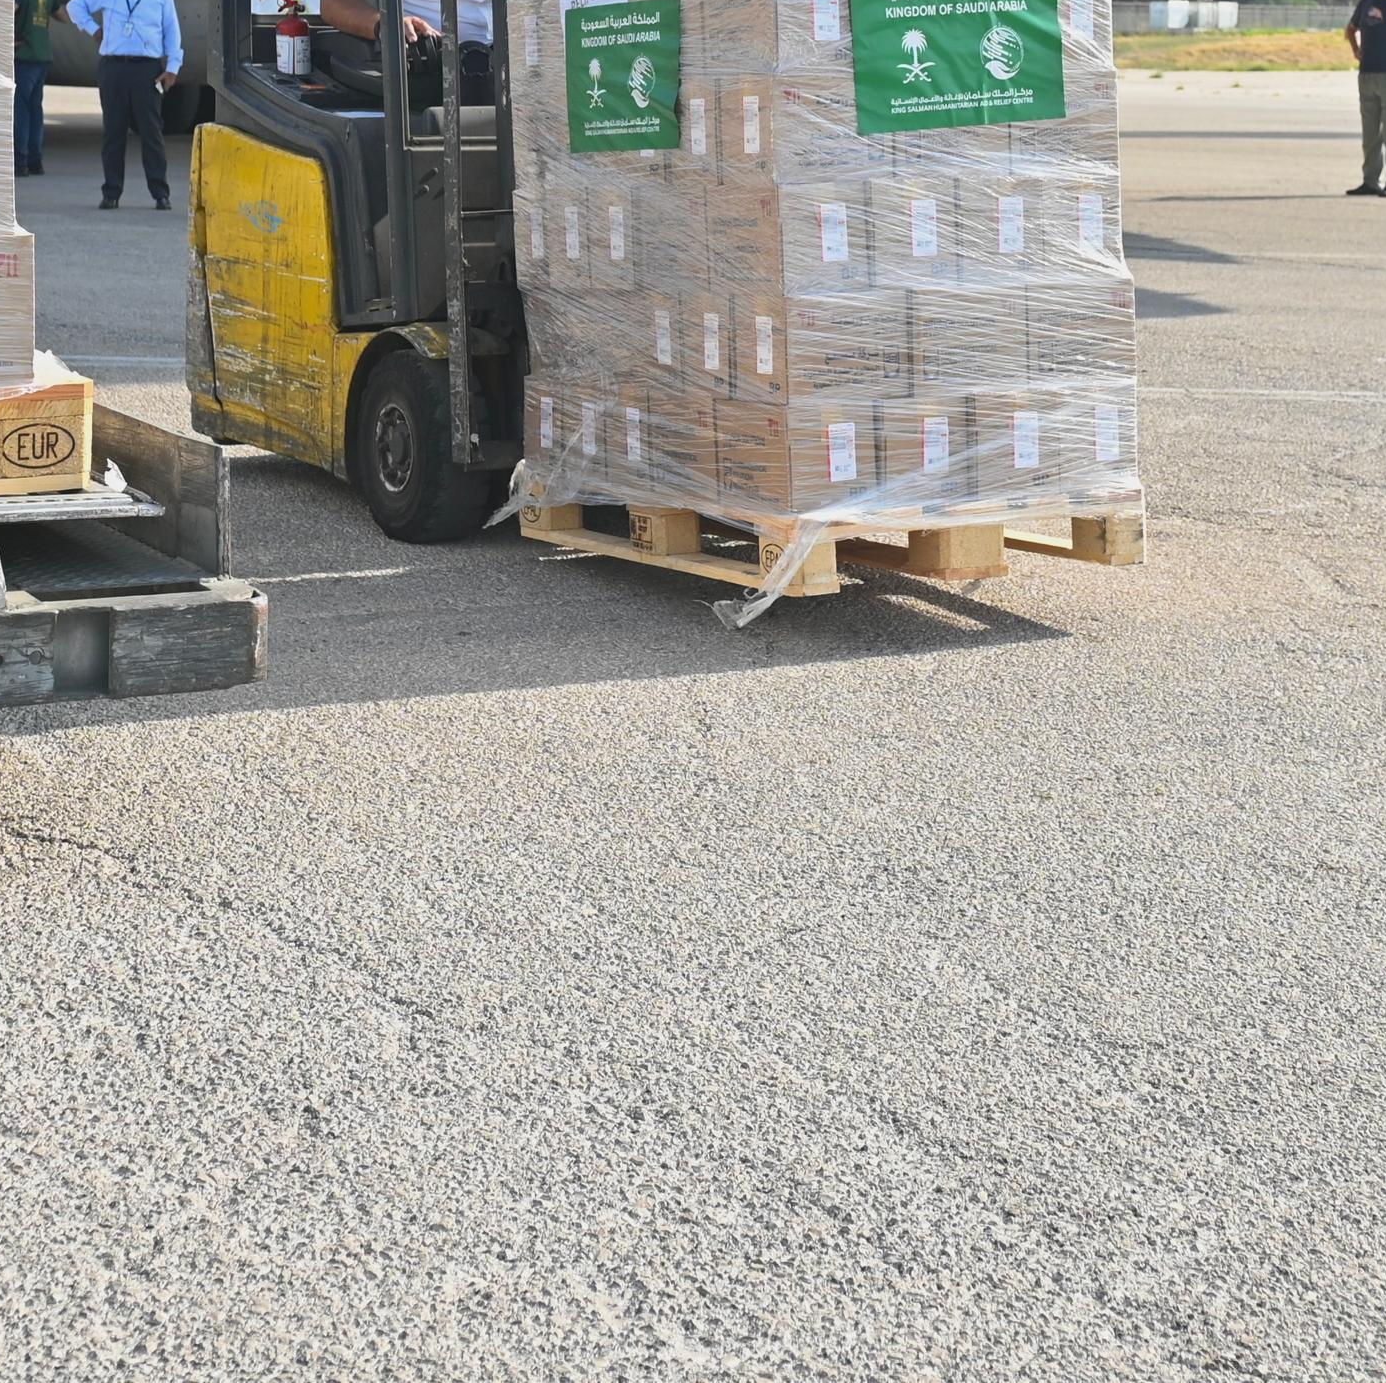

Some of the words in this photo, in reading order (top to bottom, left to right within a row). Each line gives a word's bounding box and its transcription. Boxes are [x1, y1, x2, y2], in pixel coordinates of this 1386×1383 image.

[886, 5, 936, 18] KINGDOM
[939, 4, 953, 14] OF
[956, 2, 987, 13] SAUDI
[990, 0, 1027, 12] ARABIA
[581, 18, 609, 32] السعودية
[610, 15, 632, 28] العربية
[633, 12, 660, 24] المملكة
[581, 36, 608, 48] KINGDOM
[608, 35, 615, 45] OF
[617, 33, 635, 44] SAUDI
[636, 31, 660, 42] ARABIA
[934, 102, 978, 110] HUMANITARIAN
[18, 434, 59, 462] EUR
[765, 550, 782, 564] EPA
